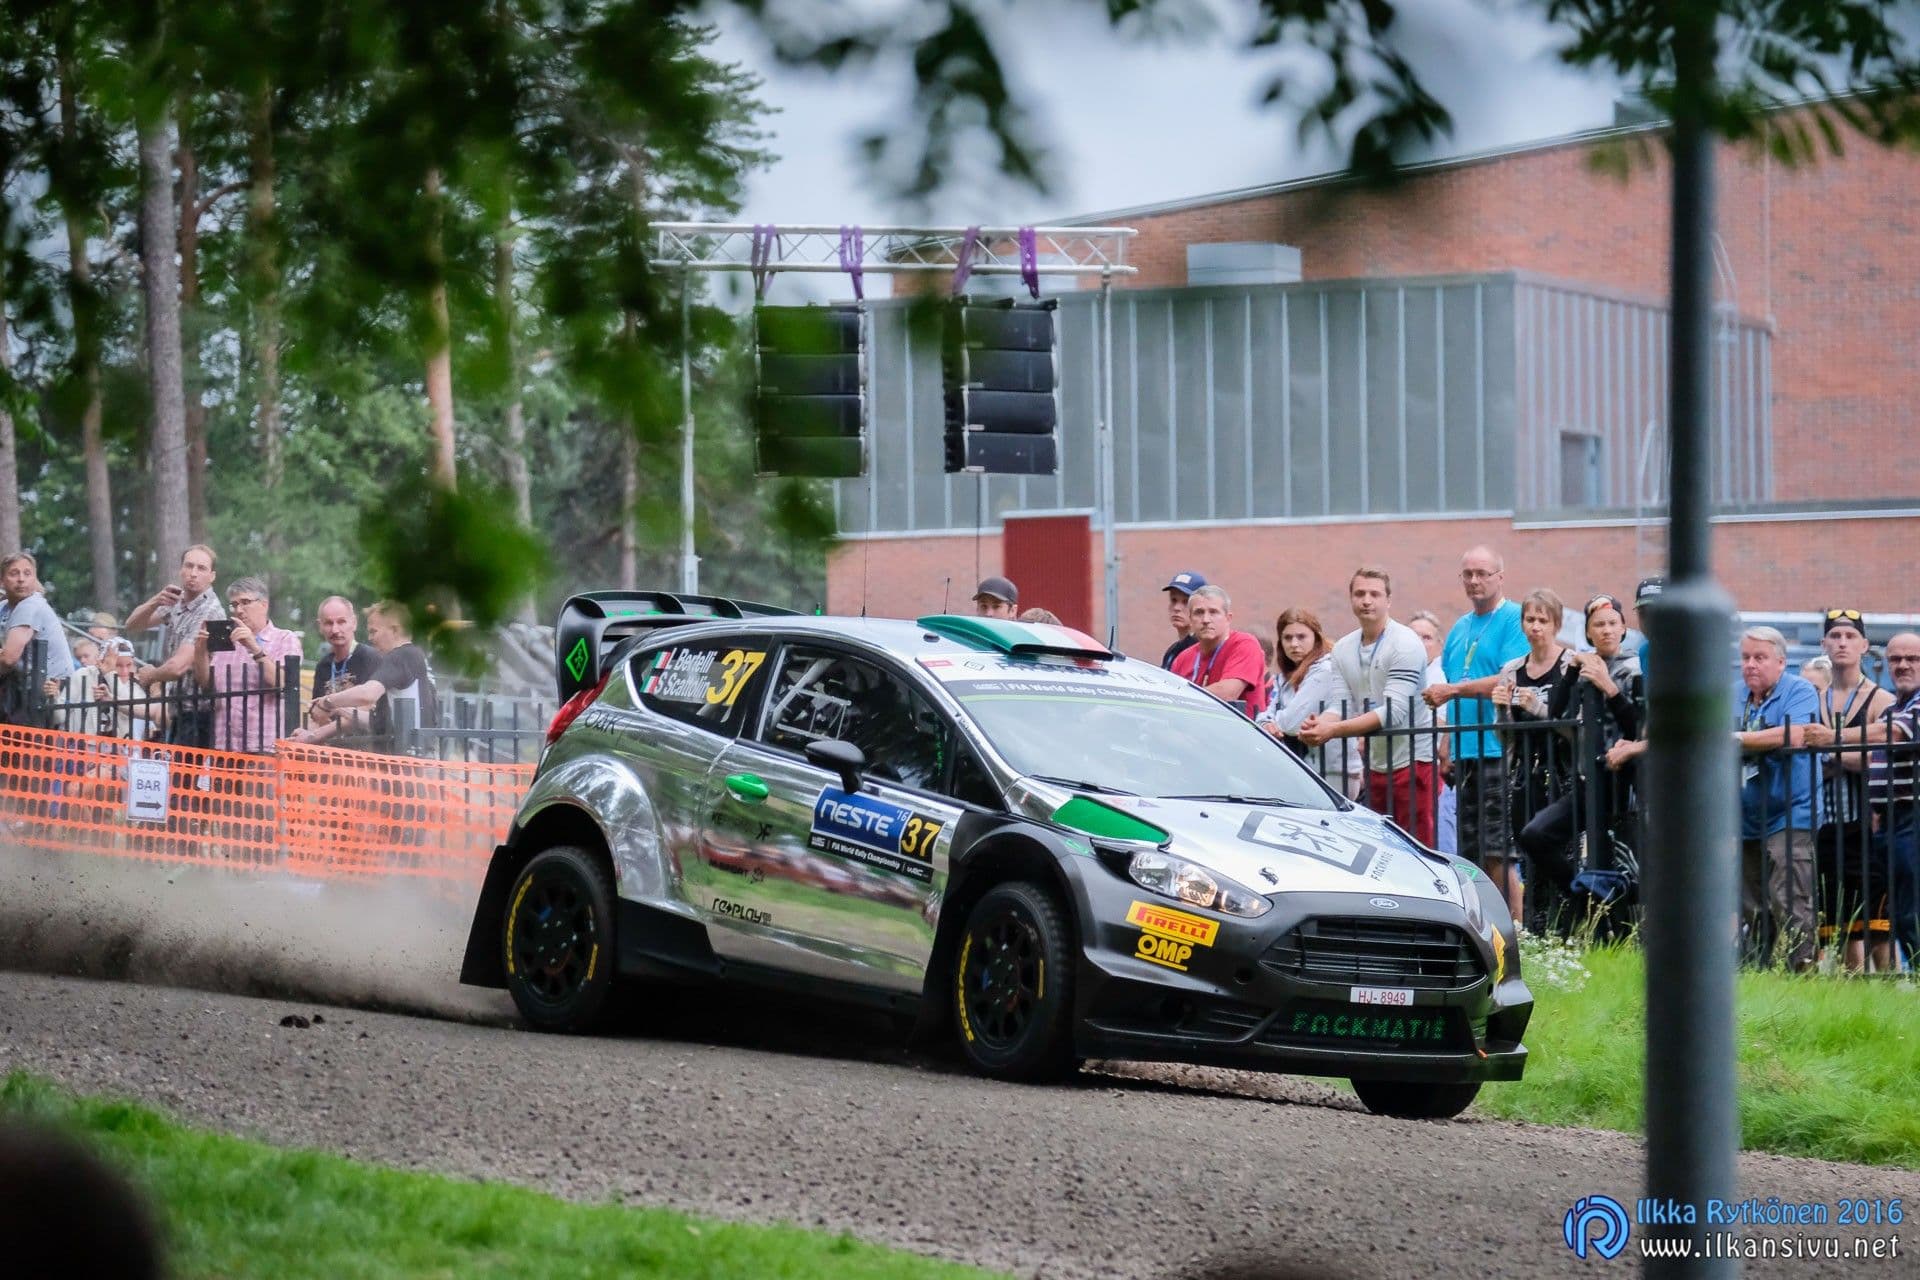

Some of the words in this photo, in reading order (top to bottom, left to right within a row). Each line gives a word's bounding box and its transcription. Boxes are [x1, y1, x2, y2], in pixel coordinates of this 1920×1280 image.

[664, 647, 677, 669] L
[674, 648, 718, 673] Bertelli
[654, 671, 667, 693] S
[664, 672, 711, 698] Scattolin
[706, 649, 767, 706] 37
[136, 779, 161, 792] BAR
[820, 799, 894, 837] NESTE
[901, 817, 941, 857] 37
[840, 843, 854, 855] World
[854, 849, 867, 860] Rally
[867, 852, 900, 870] Championship
[1136, 906, 1210, 939] PIRELLI
[1137, 935, 1192, 964] OMP
[1381, 991, 1406, 1005] 8949
